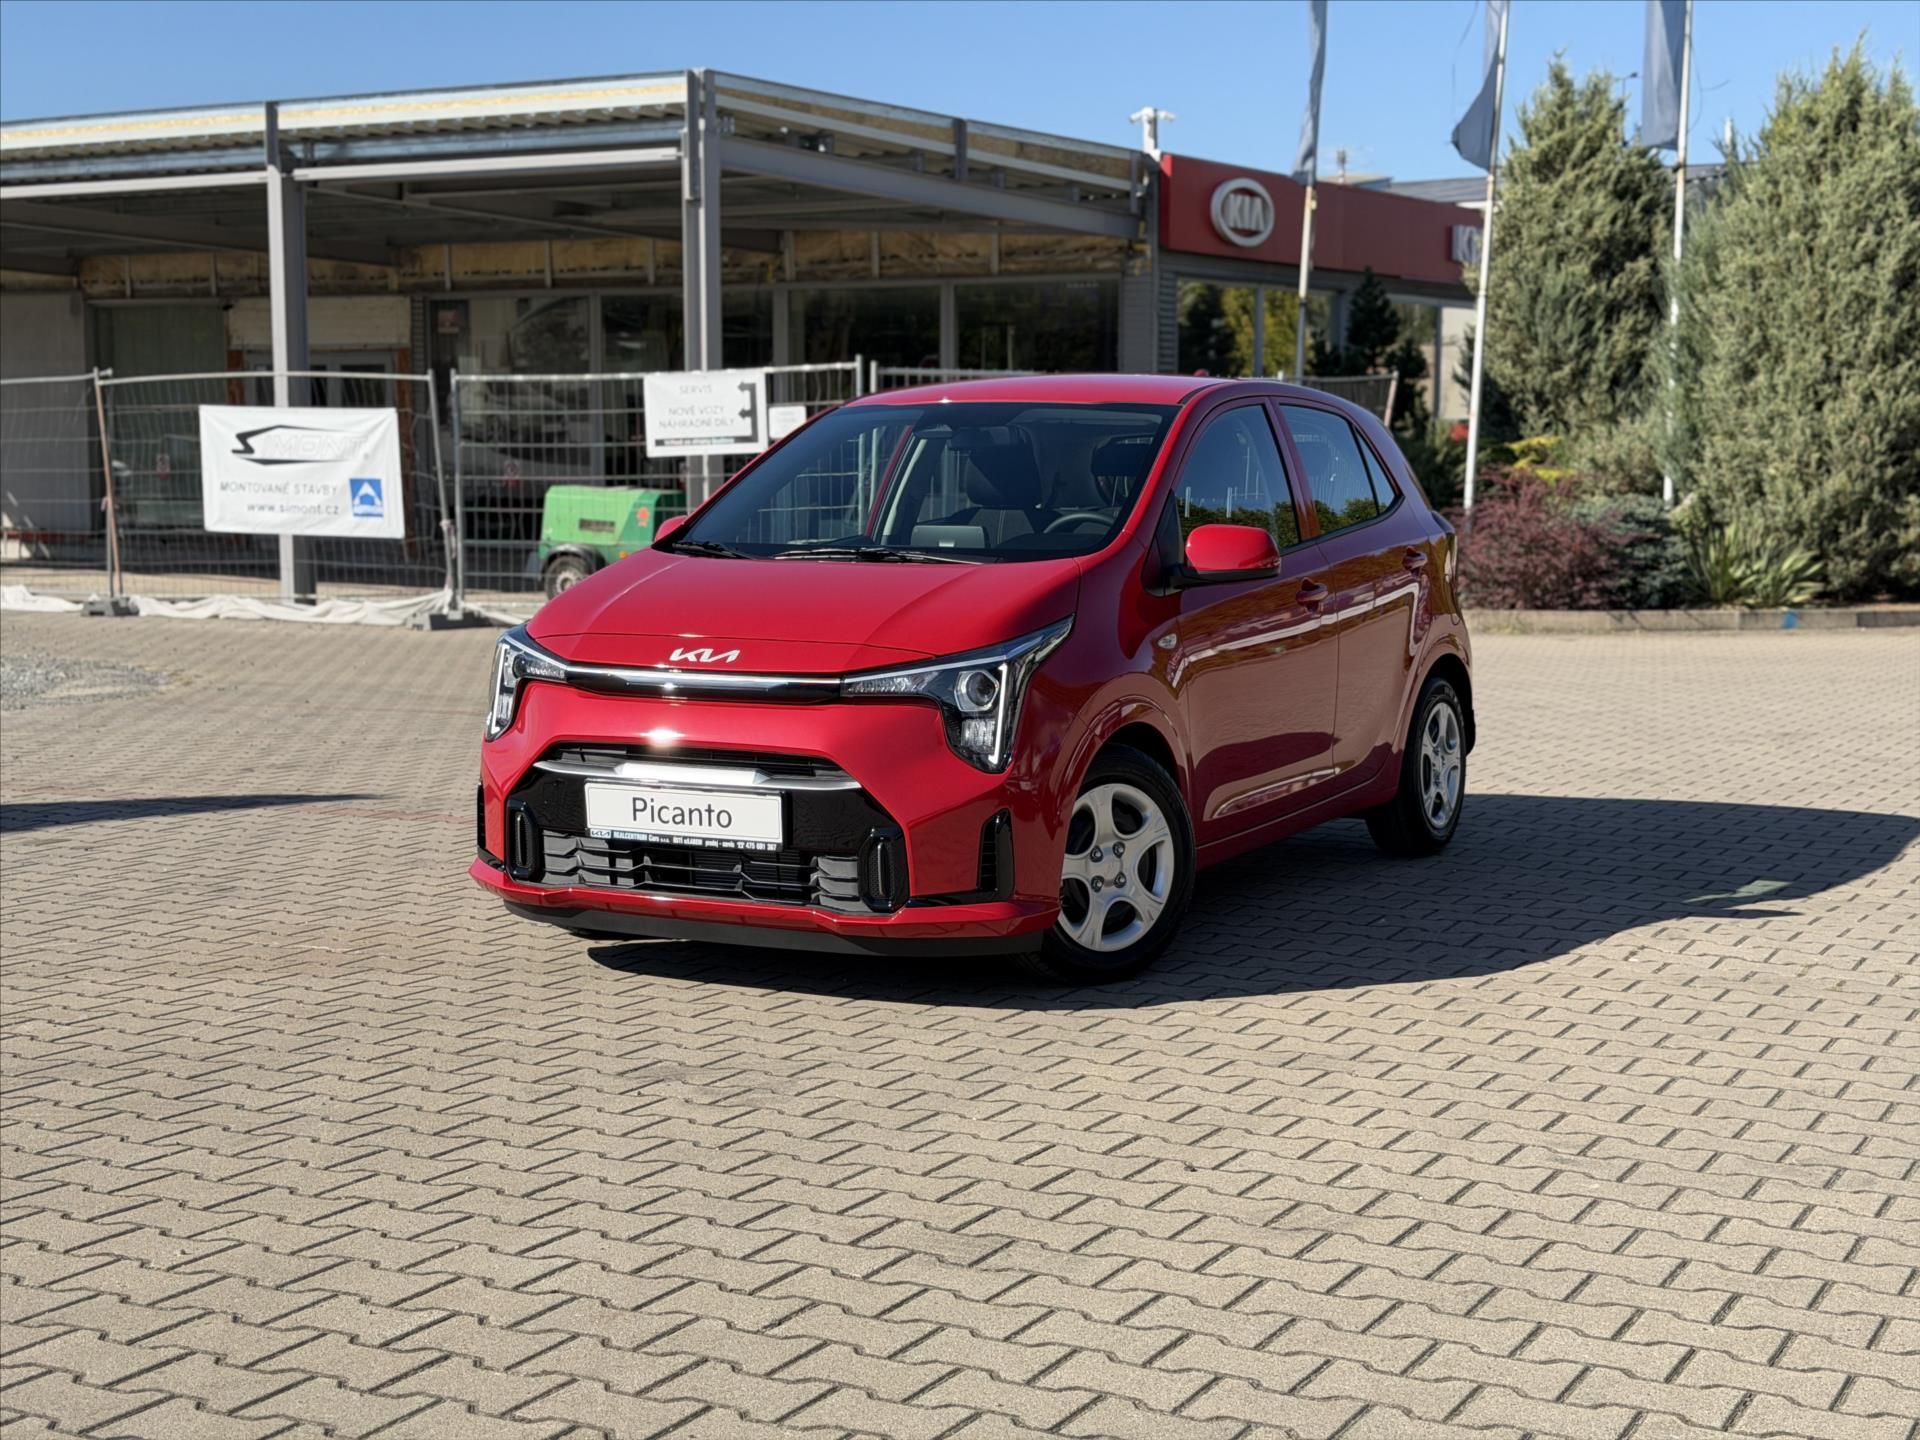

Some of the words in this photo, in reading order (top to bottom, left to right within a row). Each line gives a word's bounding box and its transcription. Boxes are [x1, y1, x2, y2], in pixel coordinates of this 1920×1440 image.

[1228, 193, 1265, 231] KIA
[680, 384, 712, 394] SERVIS
[668, 404, 696, 416] NOVÉ
[699, 404, 725, 415] VOZY
[659, 416, 712, 429] NÁHRADNÍ
[714, 415, 735, 427] DÍLY
[219, 480, 289, 496] MONTOVANÉ
[294, 482, 338, 496] STAVBY
[247, 503, 340, 516] www.simont.cz
[631, 796, 733, 829] Picanto
